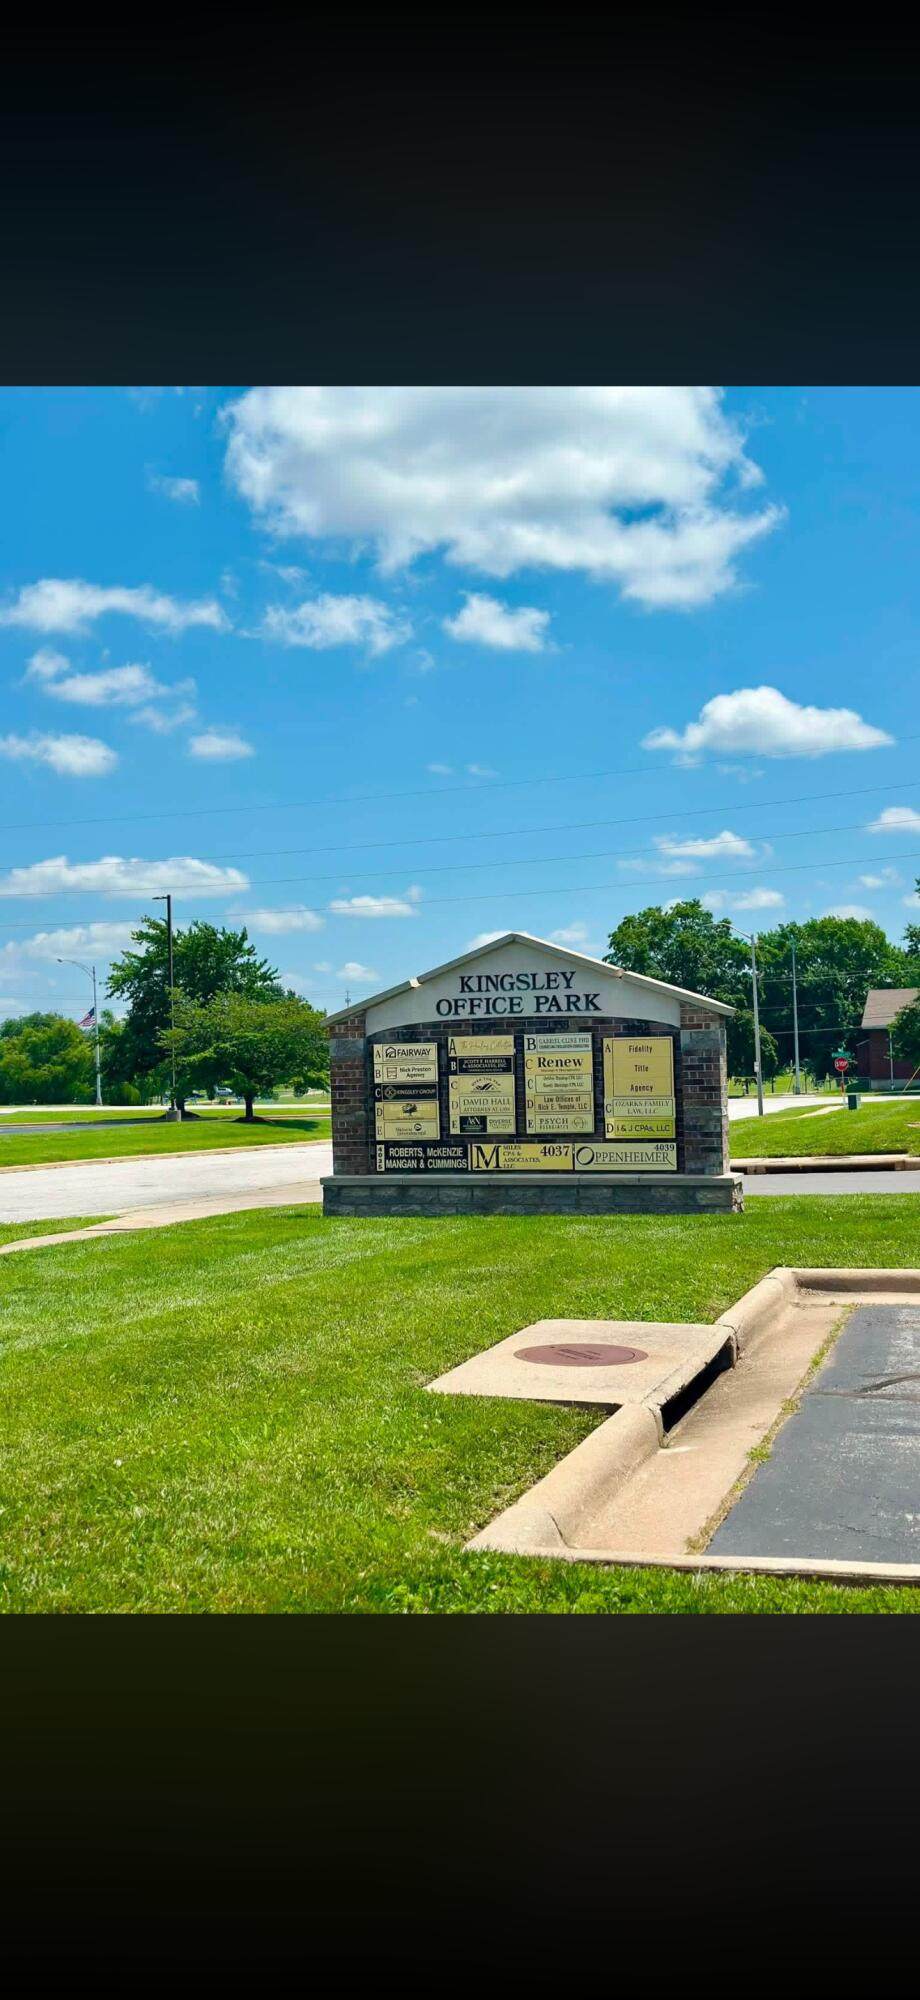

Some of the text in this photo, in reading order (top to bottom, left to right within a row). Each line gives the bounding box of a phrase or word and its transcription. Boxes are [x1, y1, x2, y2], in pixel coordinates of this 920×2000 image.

[459, 971, 576, 993] KINGSLEY
[436, 993, 602, 1016] OFFICE PARK
[450, 1038, 456, 1055] A
[526, 1038, 536, 1050] B
[605, 1044, 611, 1052] A
[375, 1050, 381, 1058] A
[397, 1048, 431, 1056] FAIRWAY
[628, 1046, 652, 1054] Fidelity
[450, 1061, 457, 1070] B
[526, 1059, 533, 1070] C
[537, 1056, 584, 1068] Renew
[375, 1069, 381, 1078] B
[450, 1080, 458, 1090] C
[528, 1078, 534, 1090] C
[375, 1088, 381, 1098] C
[451, 1100, 458, 1110] D
[528, 1100, 534, 1108] D
[606, 1104, 612, 1114] C
[376, 1108, 382, 1116] D
[528, 1120, 534, 1128] E
[606, 1122, 614, 1133] D
[390, 1148, 464, 1158] ROBERTS, McKENZIE
[474, 1145, 503, 1168] M
[540, 1146, 570, 1157] 4037
[576, 1146, 674, 1166] OPPENHEIMER
[386, 1159, 418, 1168] MANGAN
[428, 1159, 468, 1168] CUMMINGS
